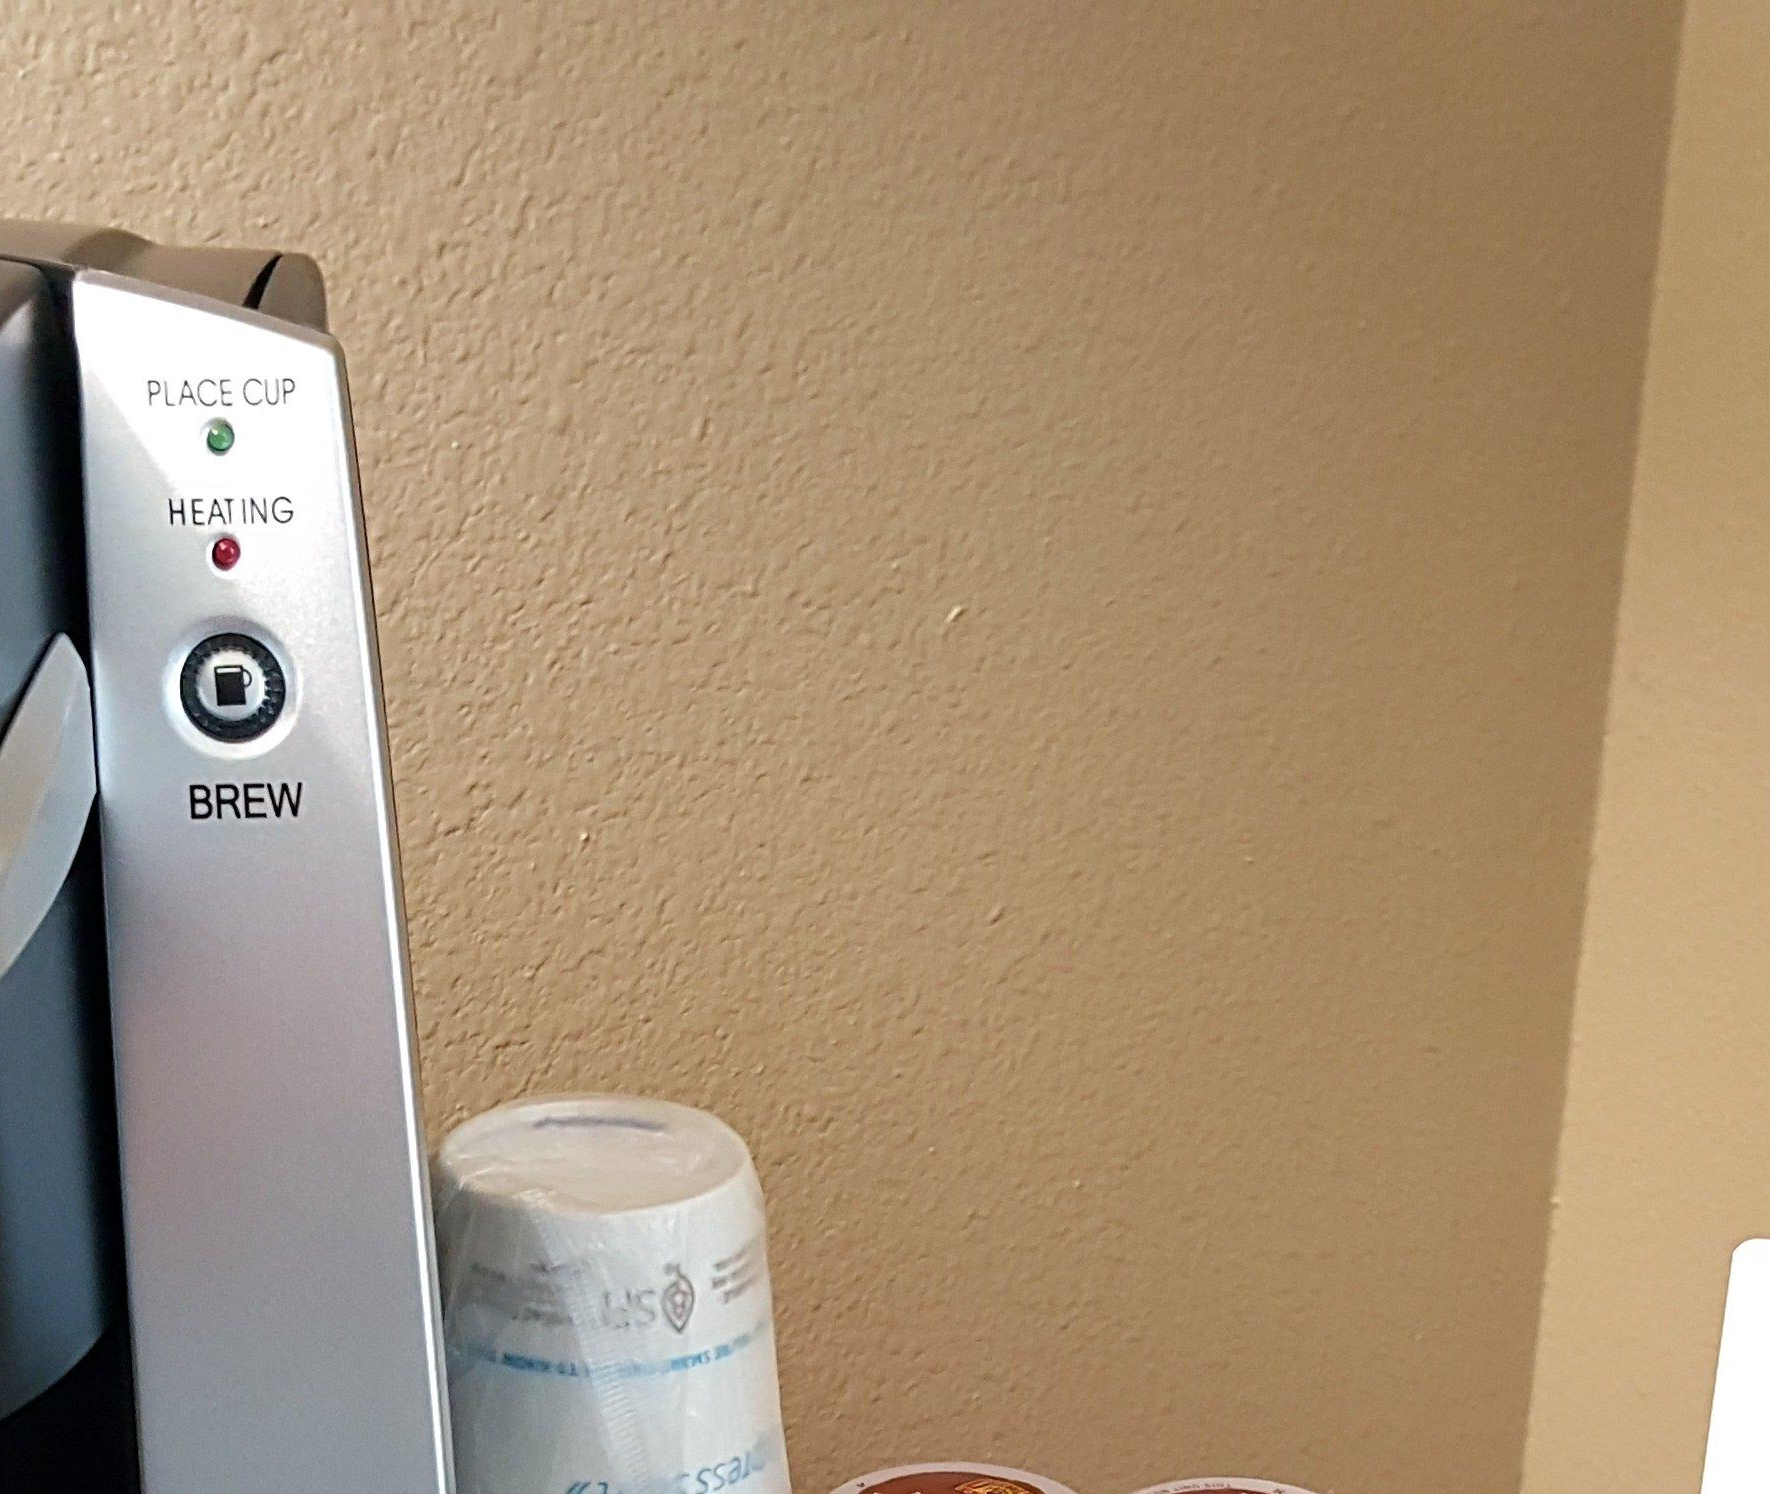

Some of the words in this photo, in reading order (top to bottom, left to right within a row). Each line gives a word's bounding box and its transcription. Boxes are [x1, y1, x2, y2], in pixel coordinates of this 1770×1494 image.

[147, 378, 233, 407] PLACE
[242, 377, 296, 406] CUP
[168, 496, 294, 526] HEATING
[189, 781, 304, 820] BREW
